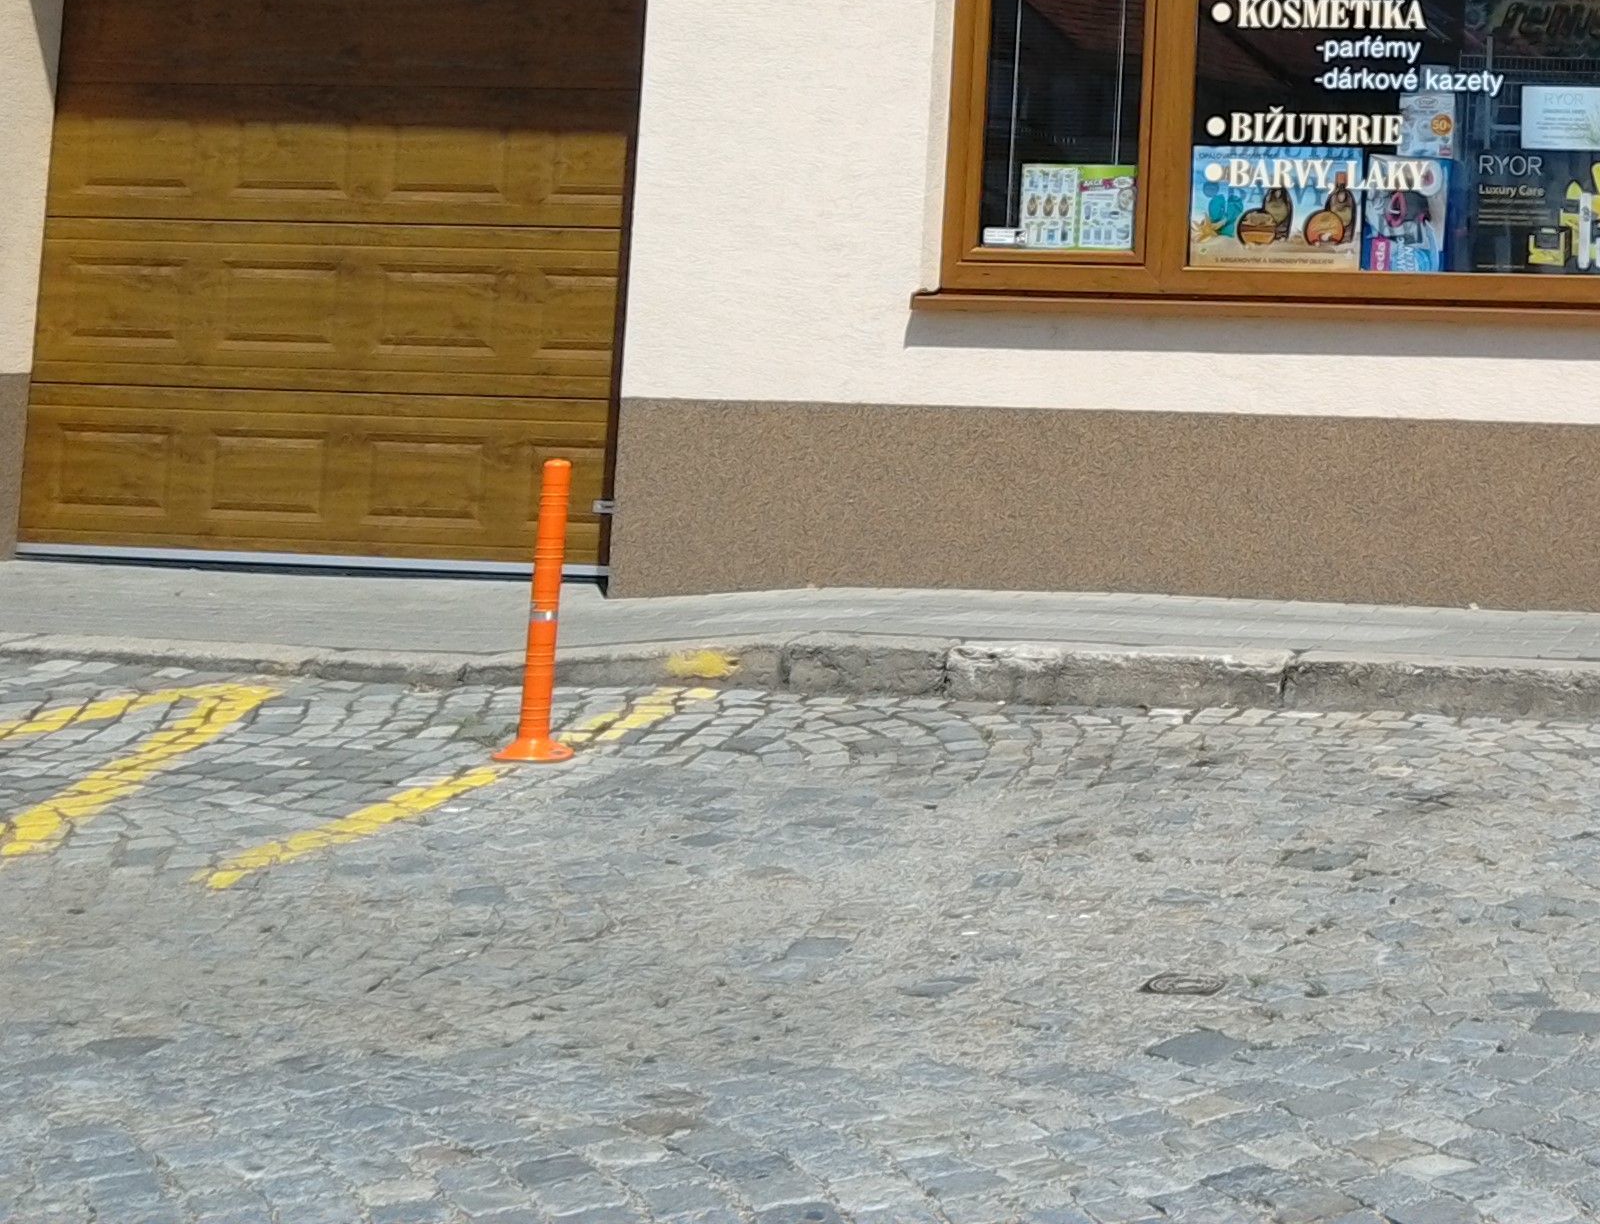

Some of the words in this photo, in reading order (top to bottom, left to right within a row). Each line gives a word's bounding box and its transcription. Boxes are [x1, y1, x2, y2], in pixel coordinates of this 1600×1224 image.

[1315, 35, 1421, 63] -parfémy
[1314, 68, 1418, 90] -dárkové
[1426, 69, 1504, 96] kazety
[1543, 92, 1584, 106] RYOR
[1230, 106, 1403, 145] BIŽUTERIE
[1228, 159, 1335, 192] BARVY,
[1346, 159, 1430, 190] LAKY
[1478, 154, 1543, 176] RYOR
[1479, 184, 1517, 198] Luxury
[1518, 184, 1545, 197] Care
